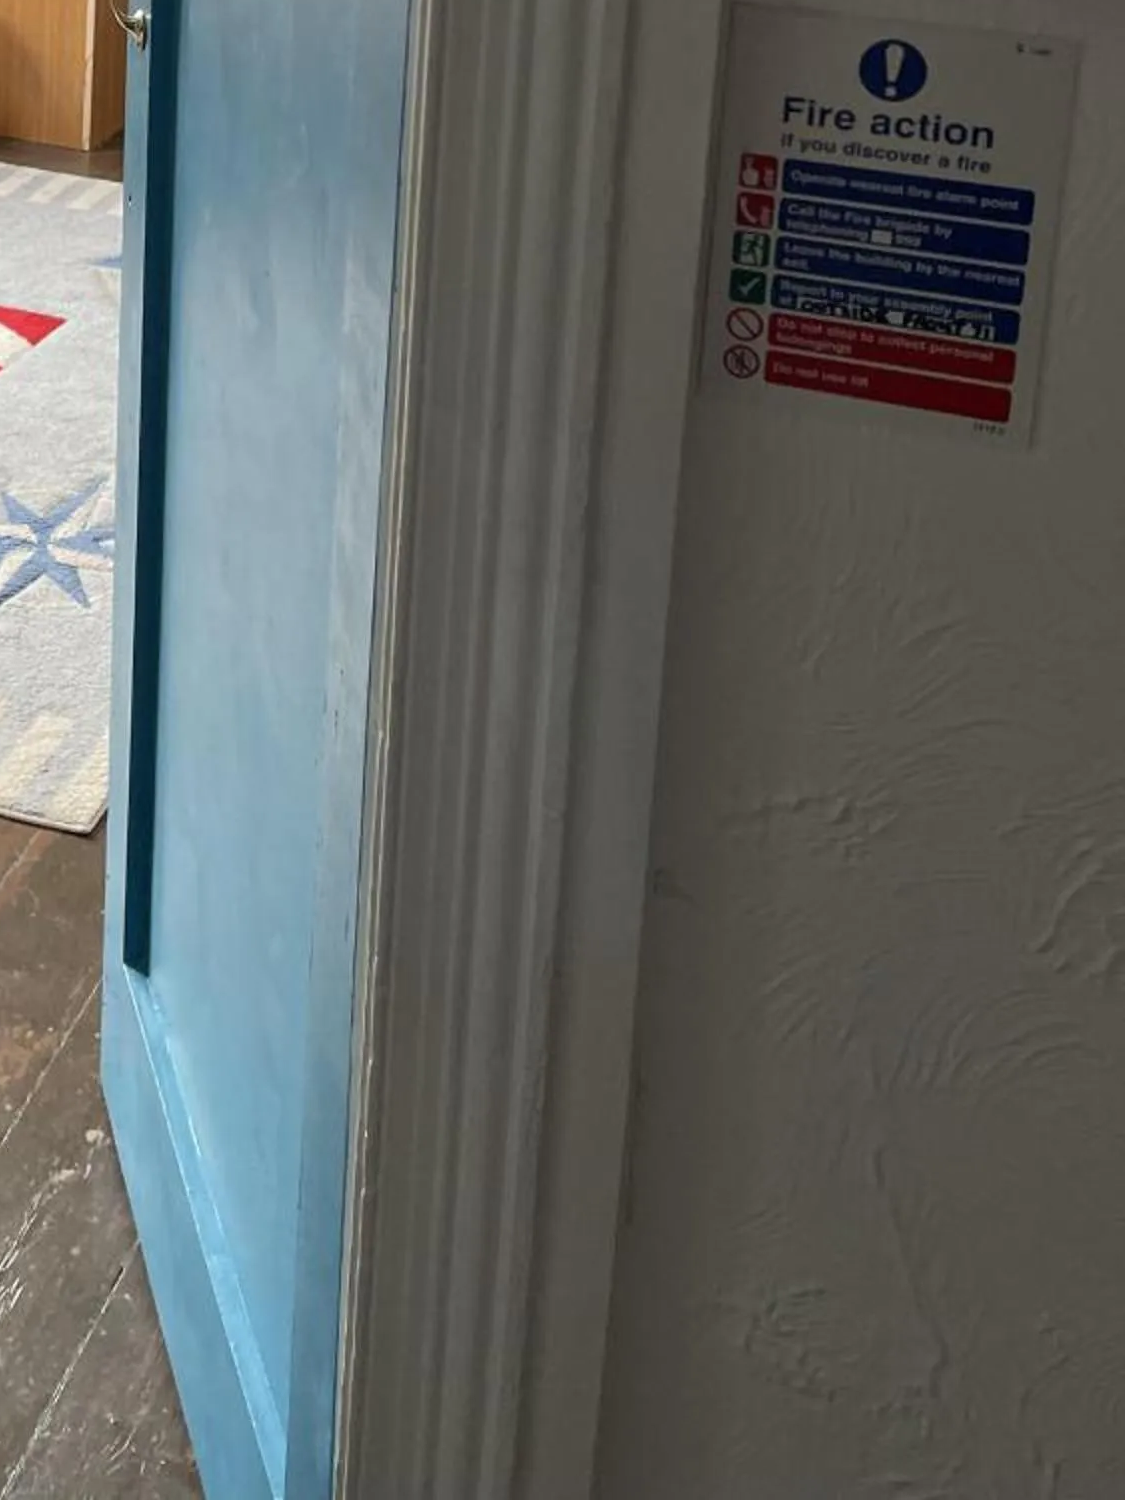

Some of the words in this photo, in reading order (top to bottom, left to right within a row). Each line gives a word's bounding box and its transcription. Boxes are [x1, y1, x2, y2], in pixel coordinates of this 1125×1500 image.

[782, 96, 856, 131] Fire
[870, 112, 994, 149] action
[799, 138, 837, 154] you
[842, 141, 931, 166] discover
[938, 156, 950, 169] a
[957, 154, 992, 174] fire
[787, 203, 815, 217] Call
[934, 222, 953, 241] by
[980, 196, 1019, 212] point
